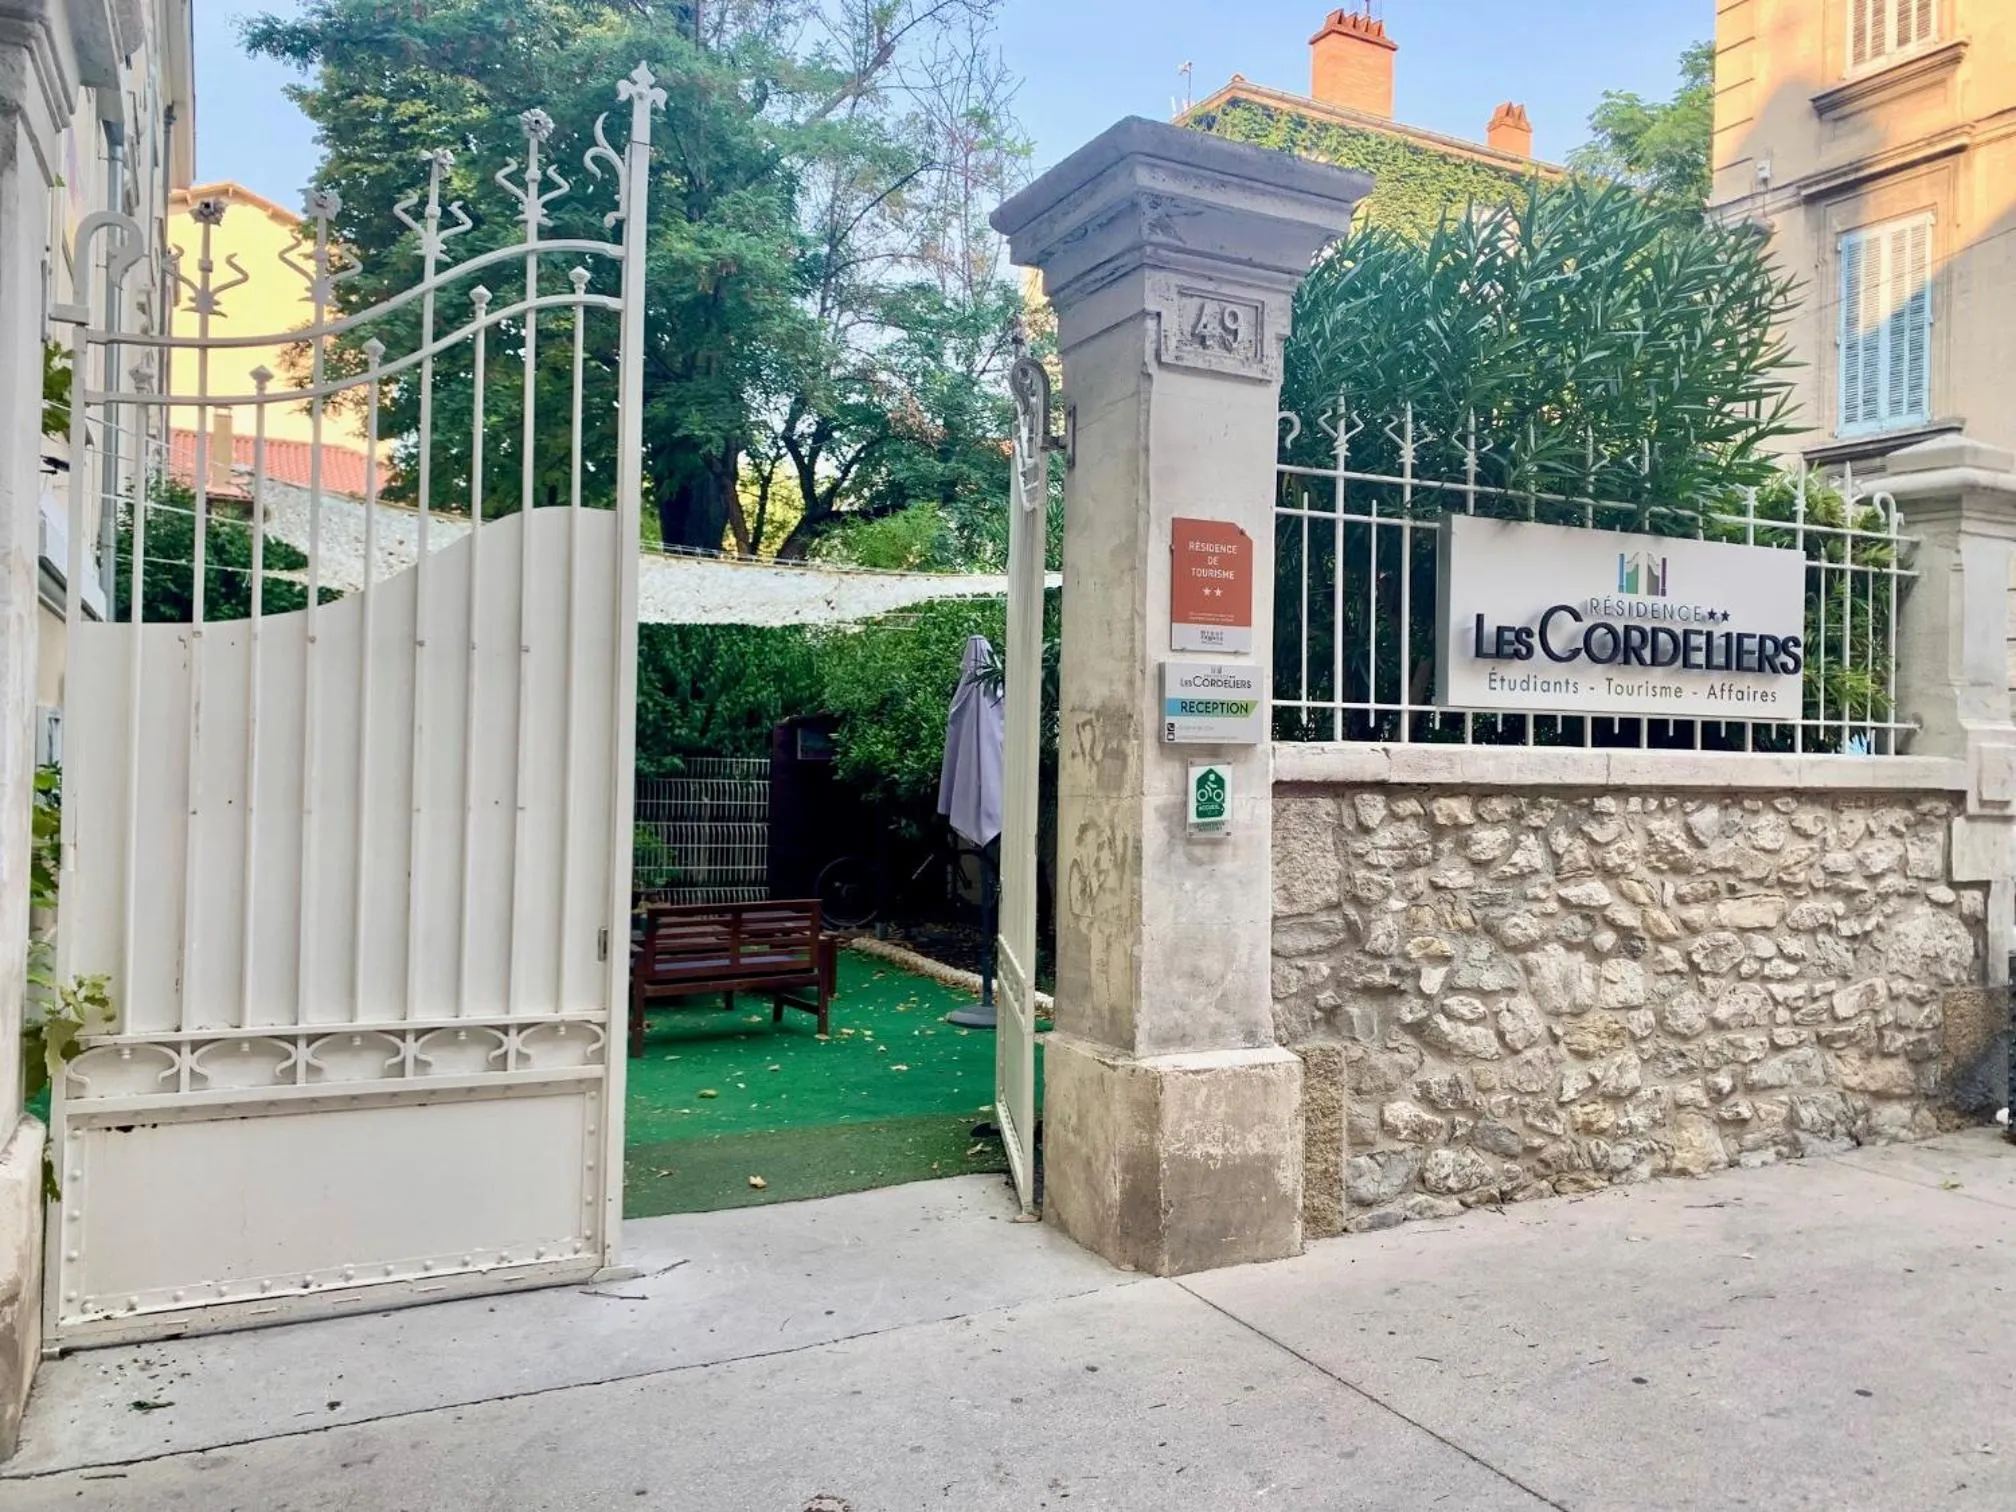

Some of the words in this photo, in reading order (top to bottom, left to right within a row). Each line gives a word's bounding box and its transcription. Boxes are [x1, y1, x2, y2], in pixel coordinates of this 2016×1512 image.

[1191, 301, 1243, 352] 49
[1208, 556, 1218, 565] DE
[1191, 568, 1235, 580] TOURISME
[1589, 595, 1702, 621] RÉSIDENCE
[1539, 604, 1802, 675] CORDELIERS
[1193, 675, 1252, 689] CORDELIERS
[1488, 667, 1579, 694] Étudiants
[1606, 678, 1684, 699] Tourisme
[1706, 686, 1778, 703] Affaires
[1180, 701, 1248, 714] RECEPTION
